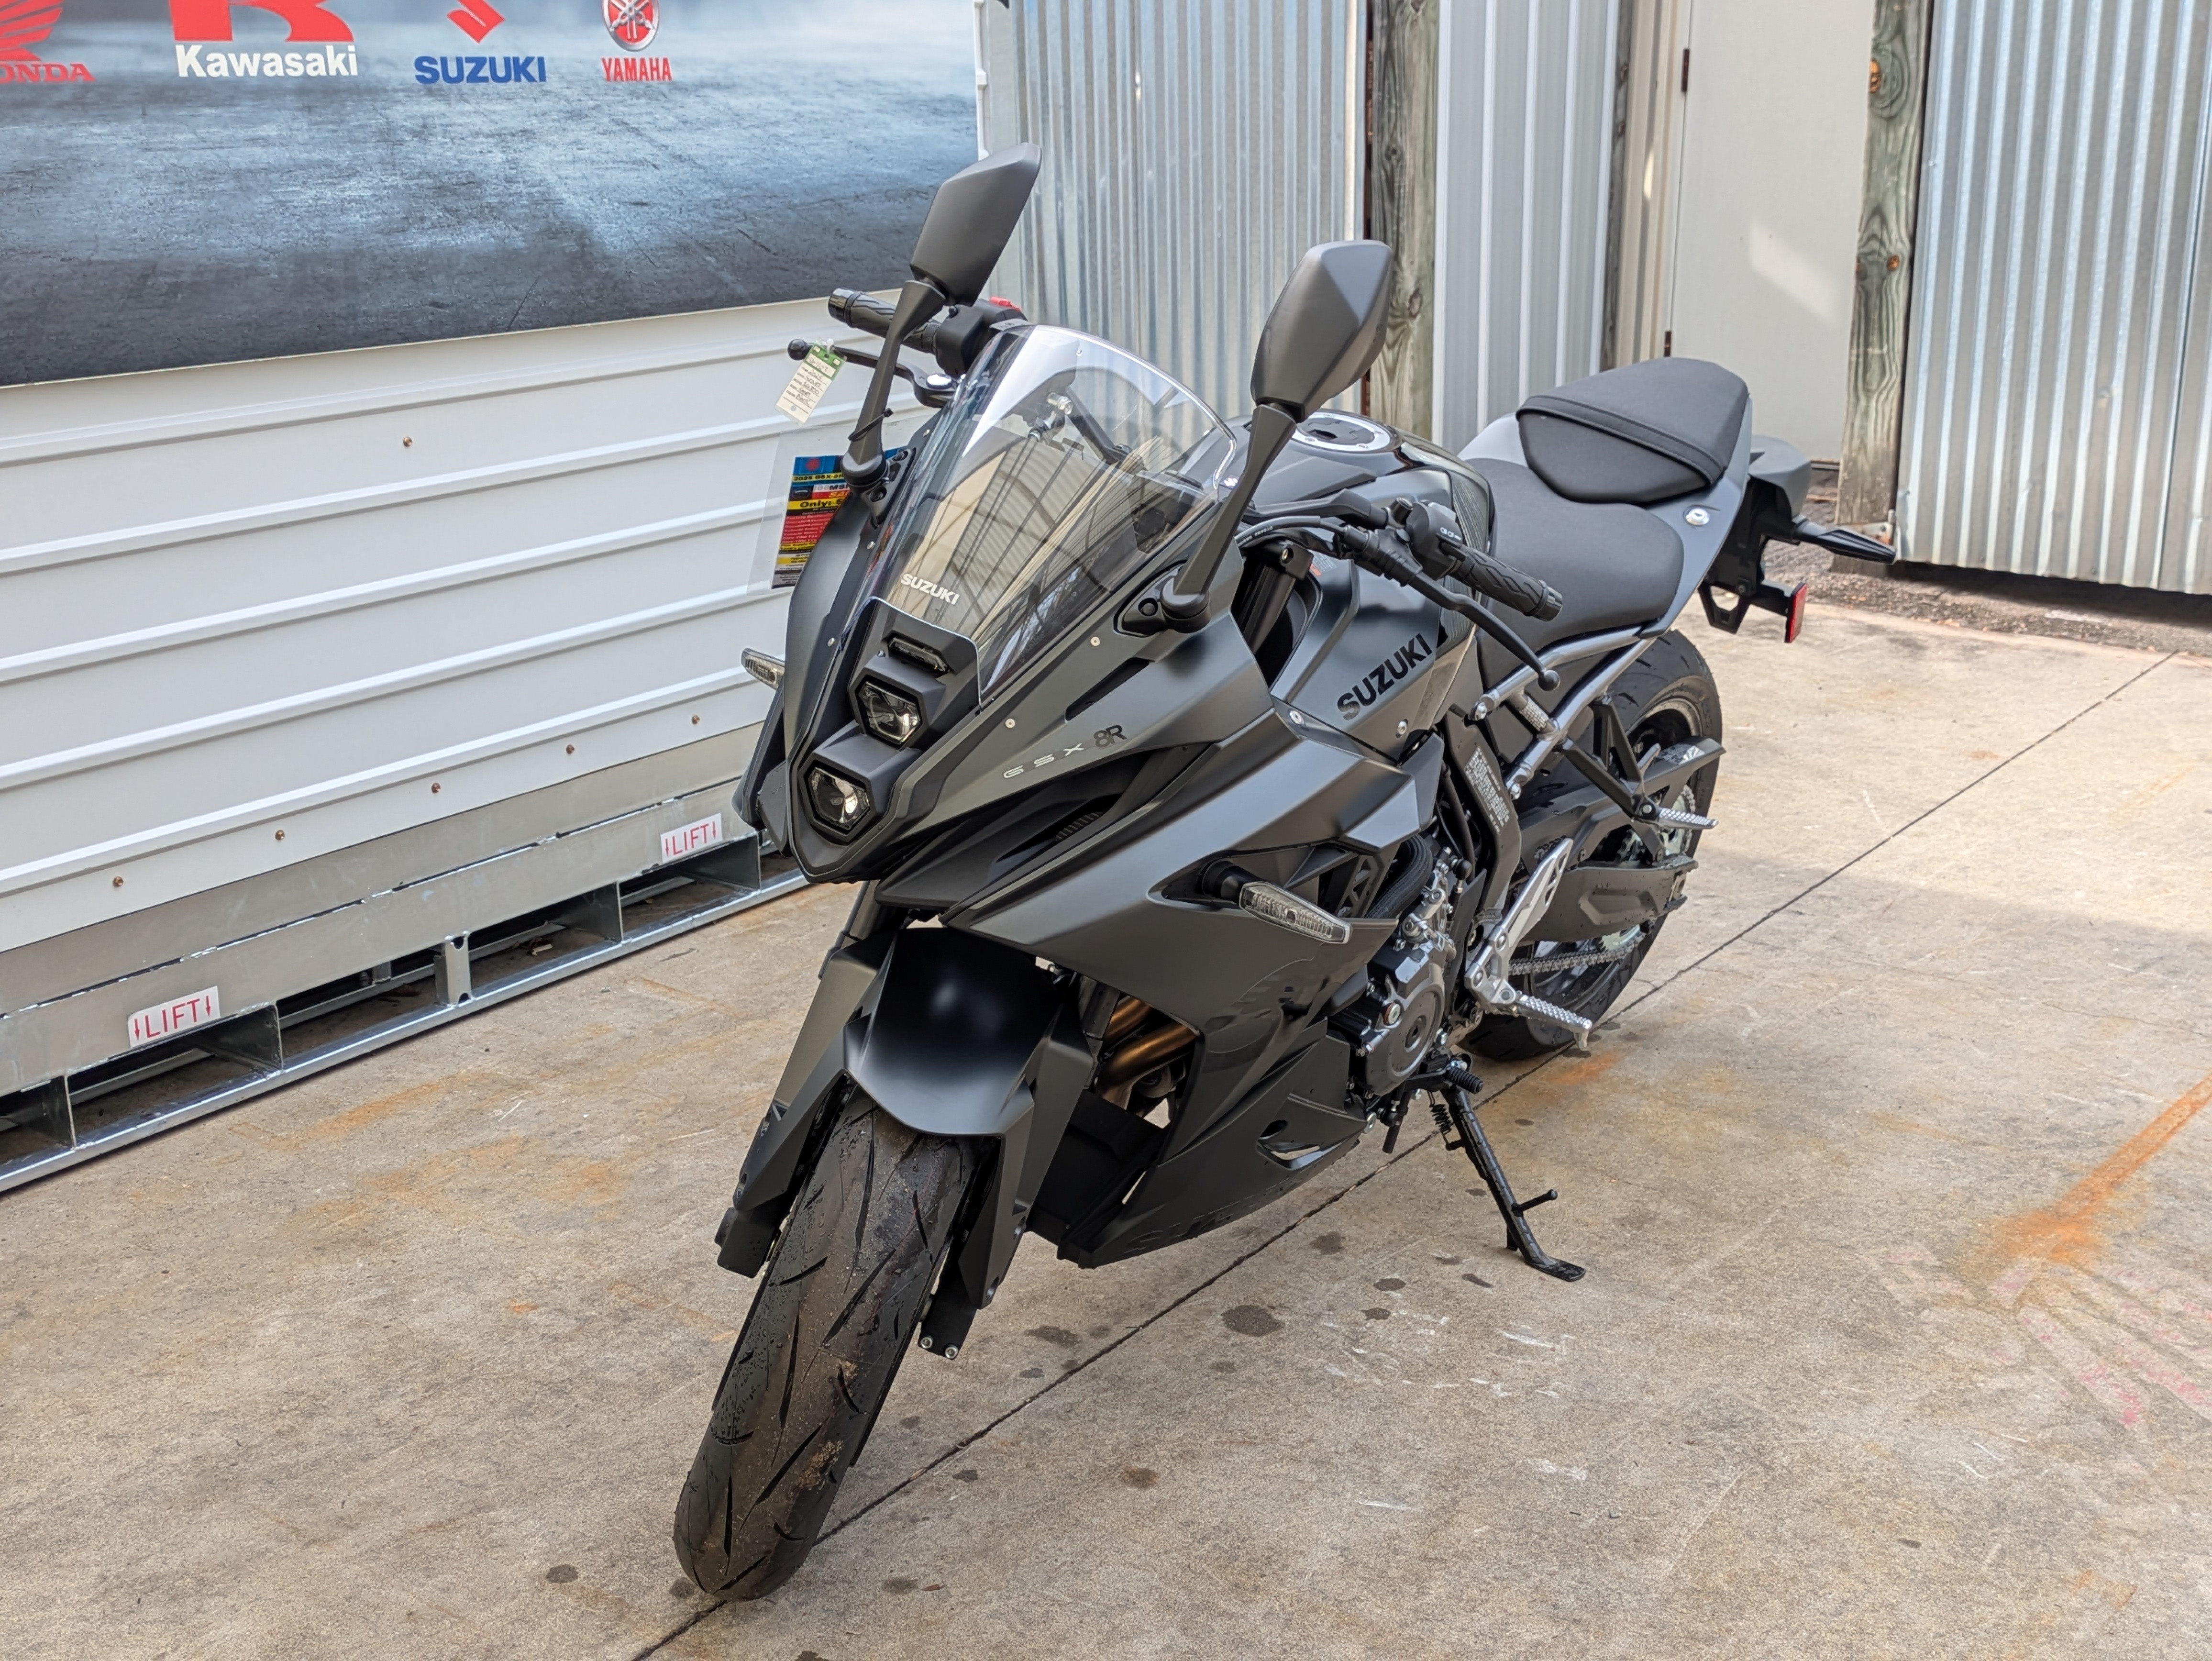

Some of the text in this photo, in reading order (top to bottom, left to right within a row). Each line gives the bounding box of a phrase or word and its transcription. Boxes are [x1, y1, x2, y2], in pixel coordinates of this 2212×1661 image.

[175, 45, 358, 77] Kawasaki
[414, 56, 547, 83] SUZUKI
[601, 57, 673, 81] YAMAHA
[901, 574, 960, 605] SUZUKI
[1337, 633, 1432, 720] SUZUKI
[673, 823, 709, 855] LIFT
[145, 998, 200, 1038] LIFT
